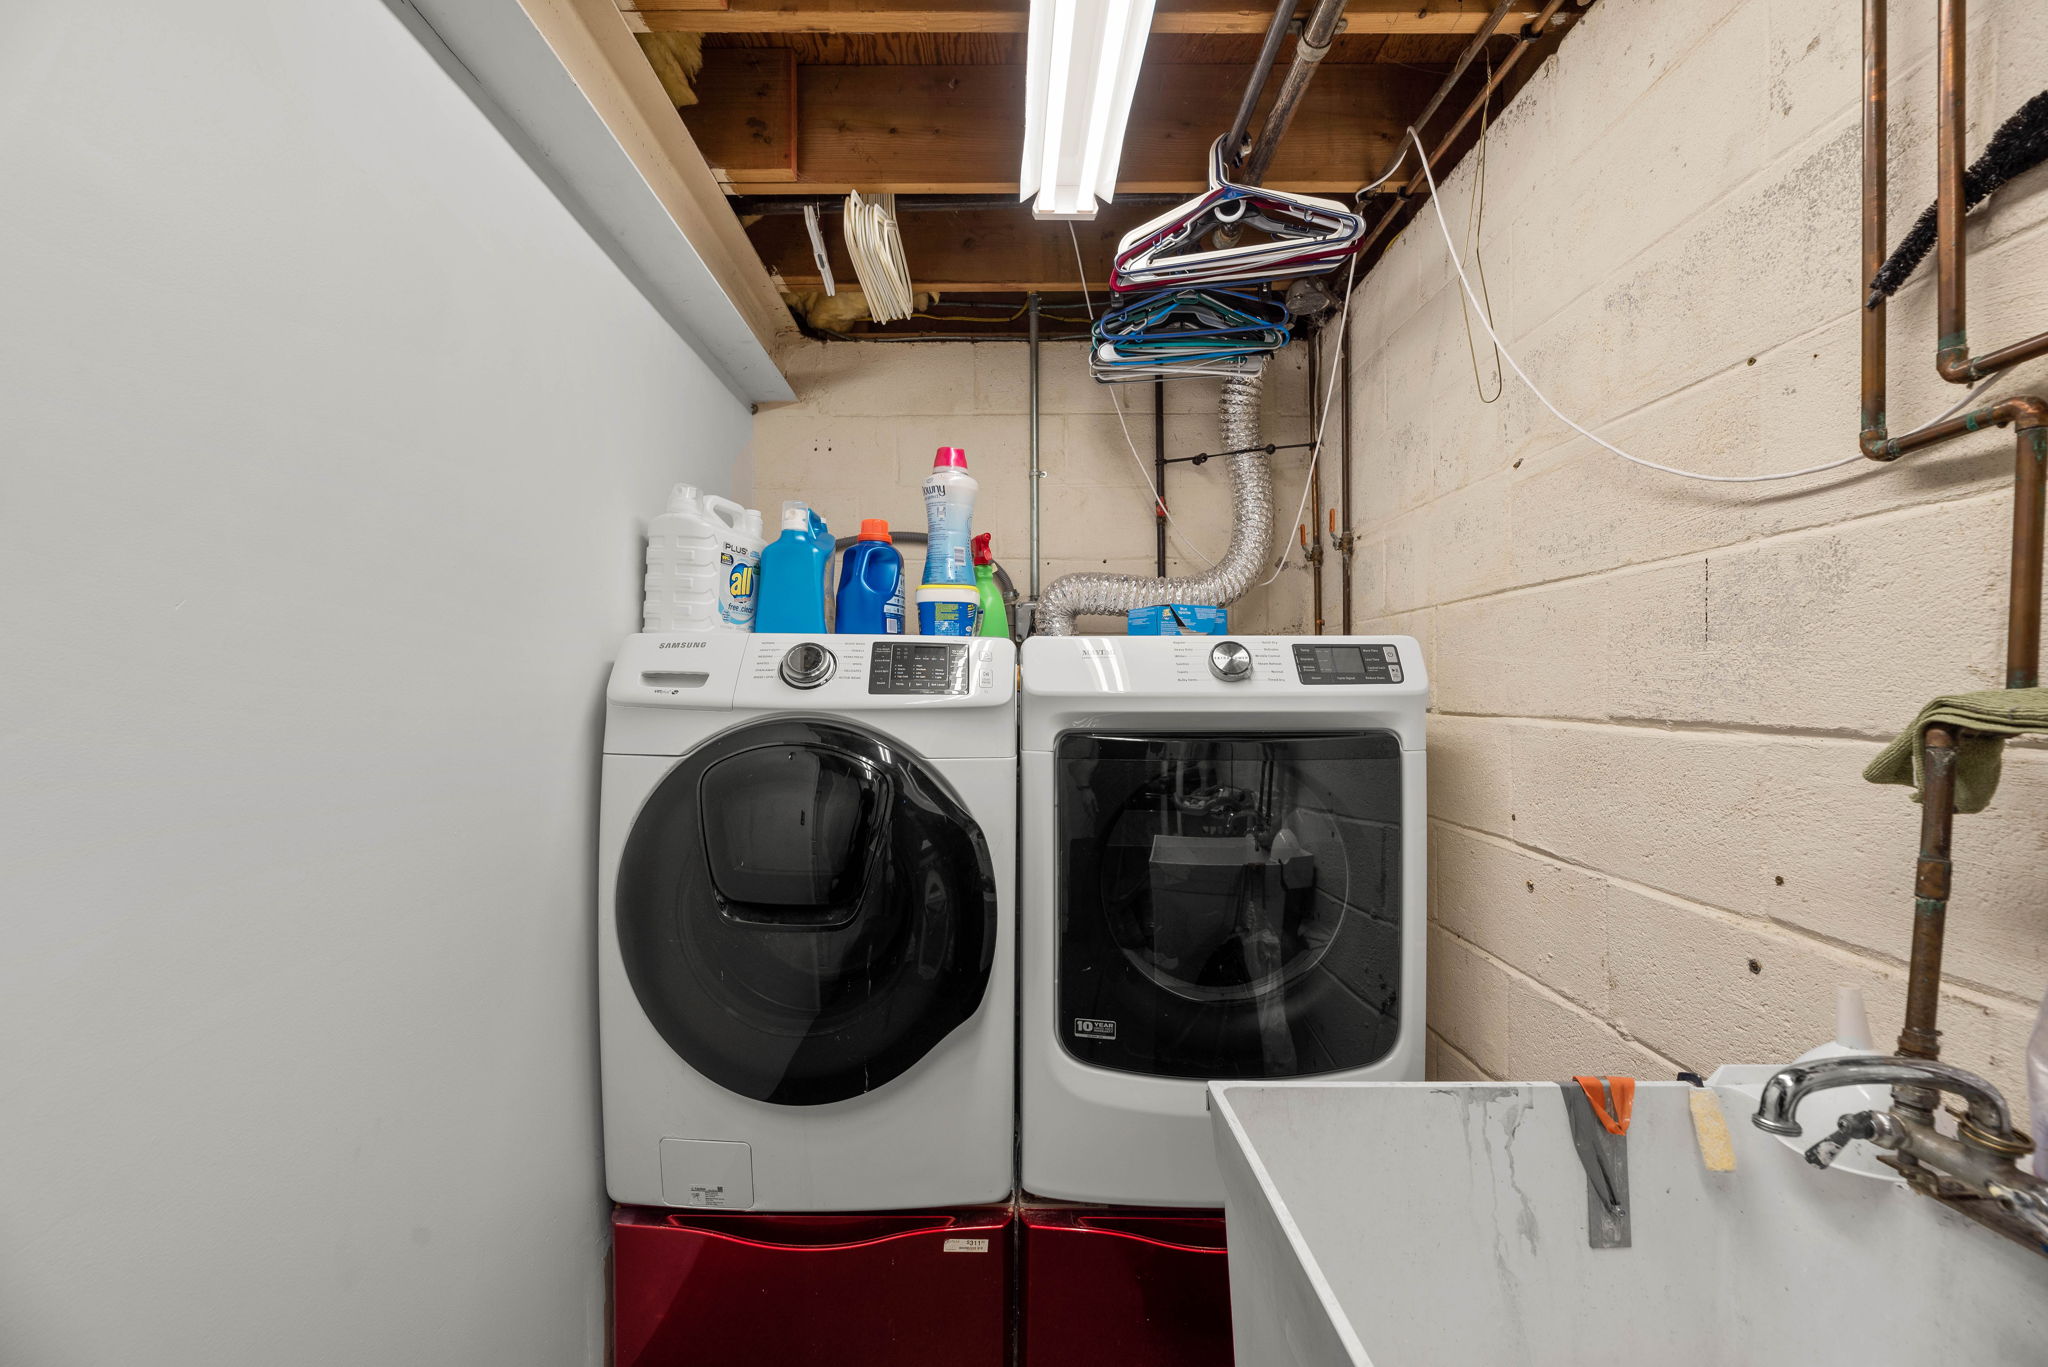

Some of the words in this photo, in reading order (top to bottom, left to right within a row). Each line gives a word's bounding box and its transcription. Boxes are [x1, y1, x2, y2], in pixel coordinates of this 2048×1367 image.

[725, 543, 748, 555] PLUS
[730, 567, 753, 596] all
[658, 641, 707, 649] SAMSUNG
[1077, 1020, 1093, 1032] 10
